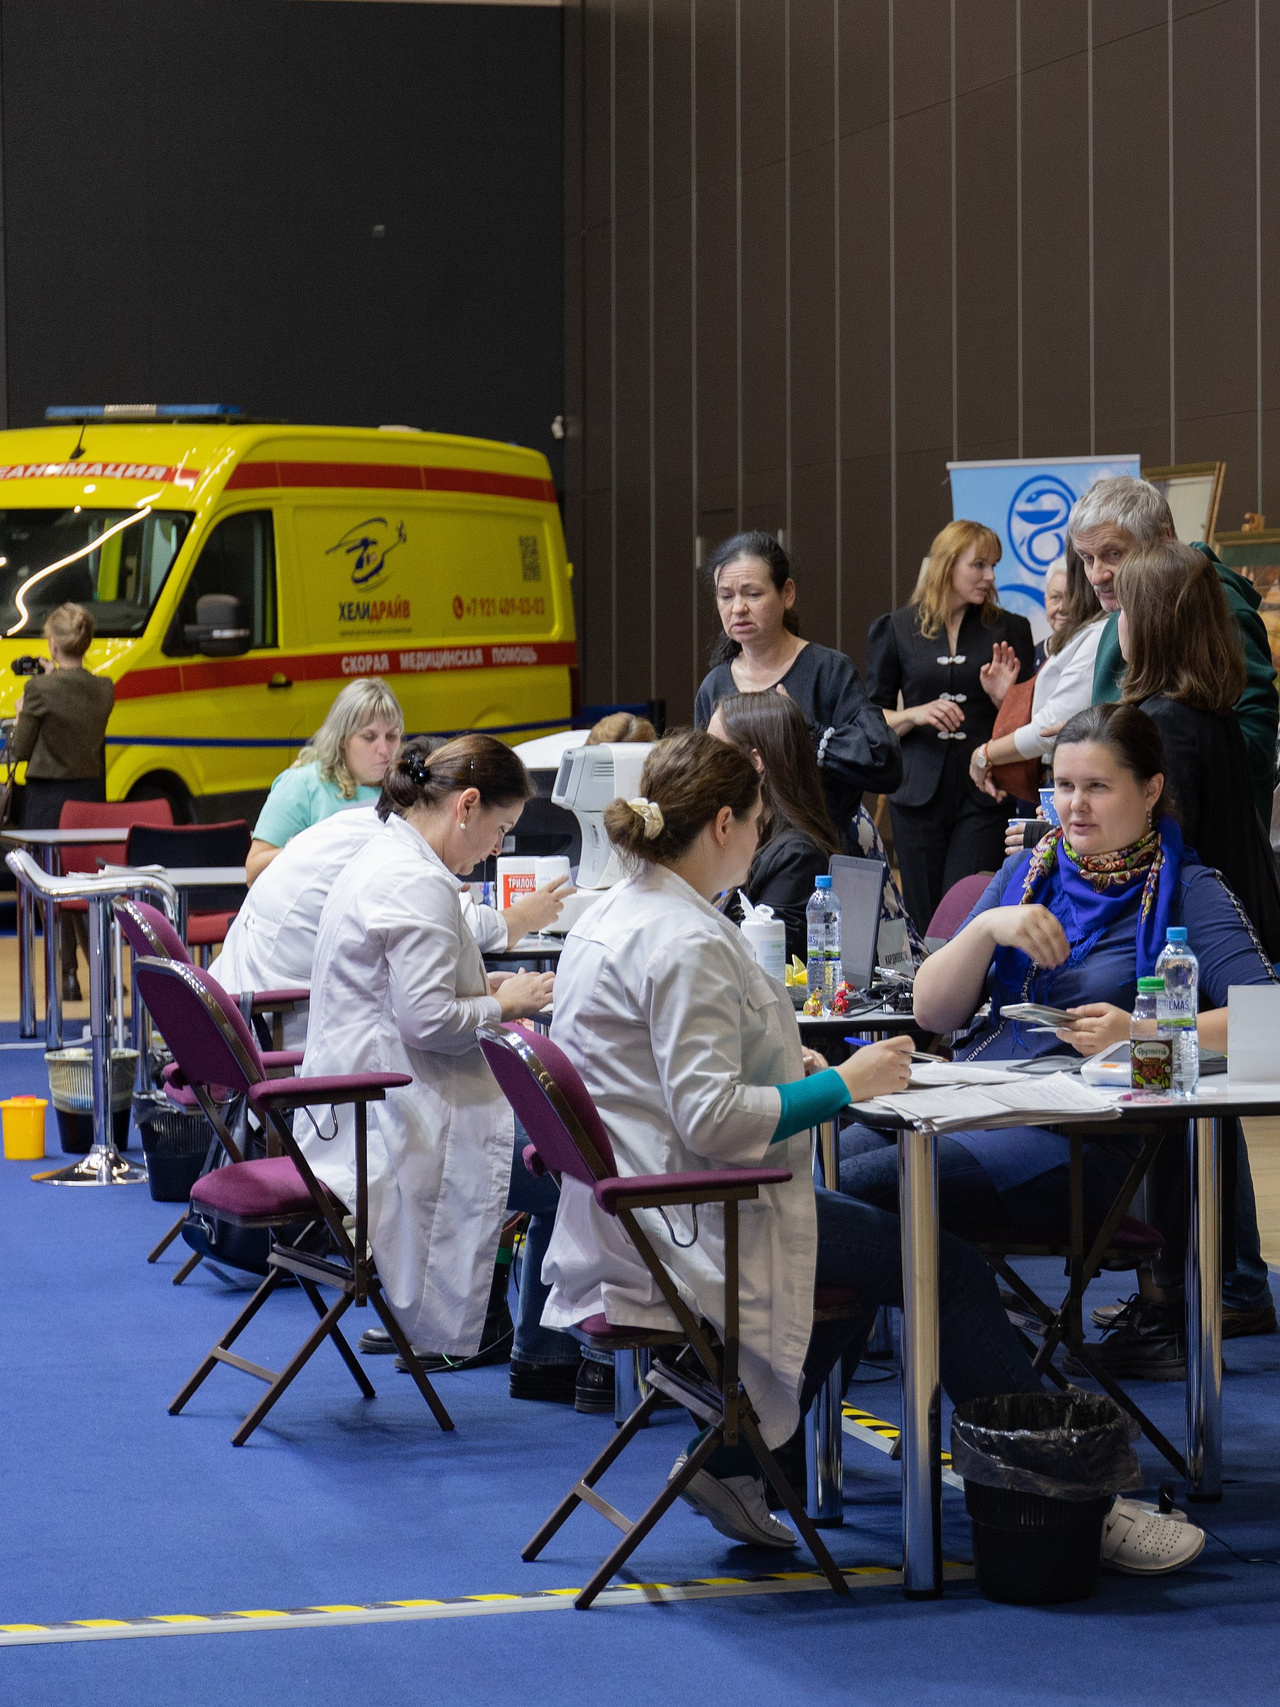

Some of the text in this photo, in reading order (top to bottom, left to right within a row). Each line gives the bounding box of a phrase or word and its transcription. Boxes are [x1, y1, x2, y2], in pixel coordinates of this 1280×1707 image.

[0, 461, 168, 481] ЕАНИМАЦИЯ
[339, 595, 411, 622] ХЕЛИДРАЙВ
[341, 646, 538, 674] СКОРАЯ МЕДИЦИНСКАЯ ПОМОЩЬ
[508, 877, 537, 889] ТРИЛОК
